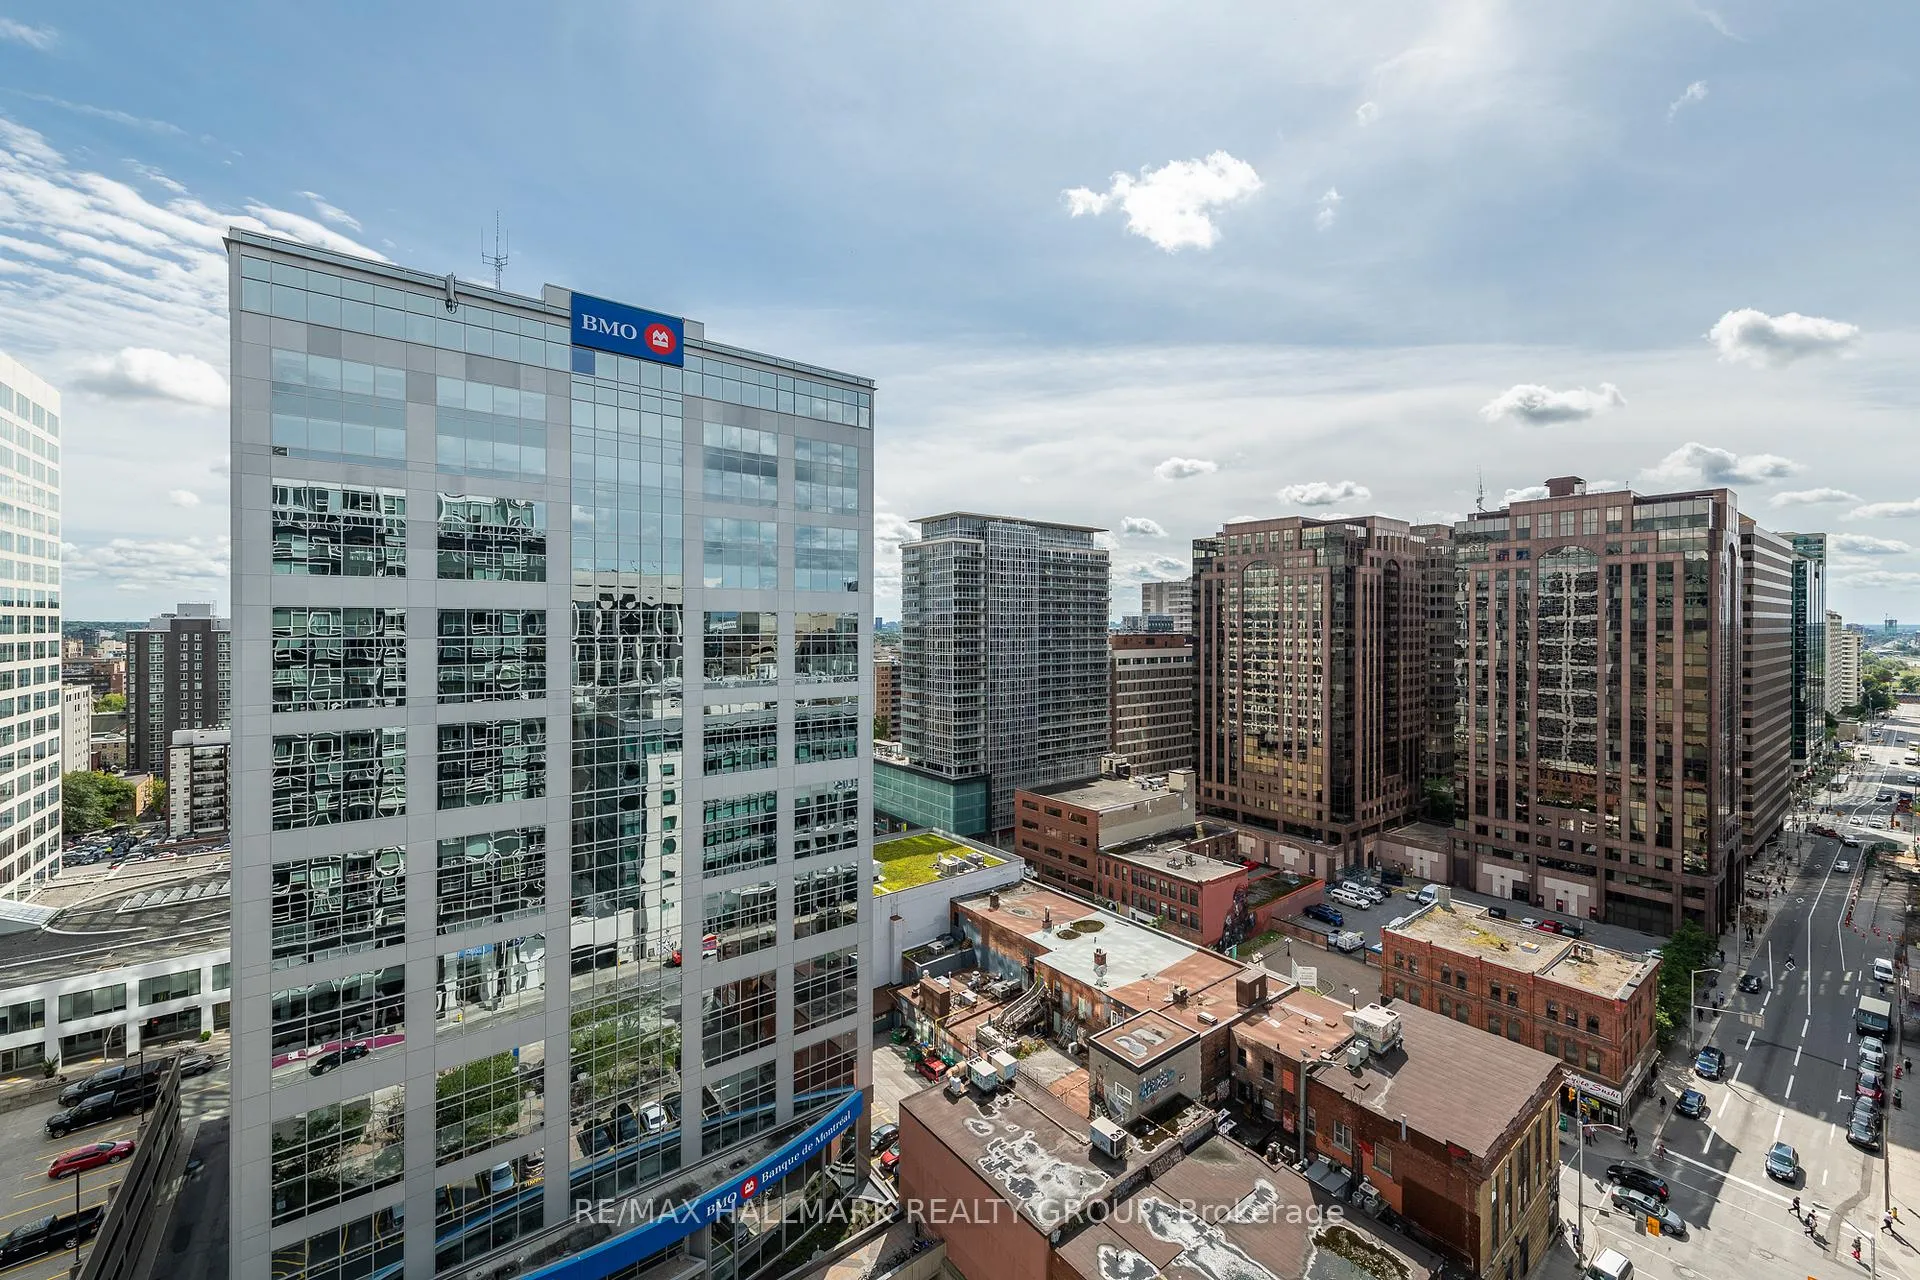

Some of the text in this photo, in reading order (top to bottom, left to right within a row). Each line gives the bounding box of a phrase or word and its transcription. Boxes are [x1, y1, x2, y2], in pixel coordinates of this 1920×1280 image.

[581, 313, 637, 340] BMO
[1589, 1083, 1620, 1099] Sushi
[706, 1110, 851, 1217] BMO Banque de Montréal
